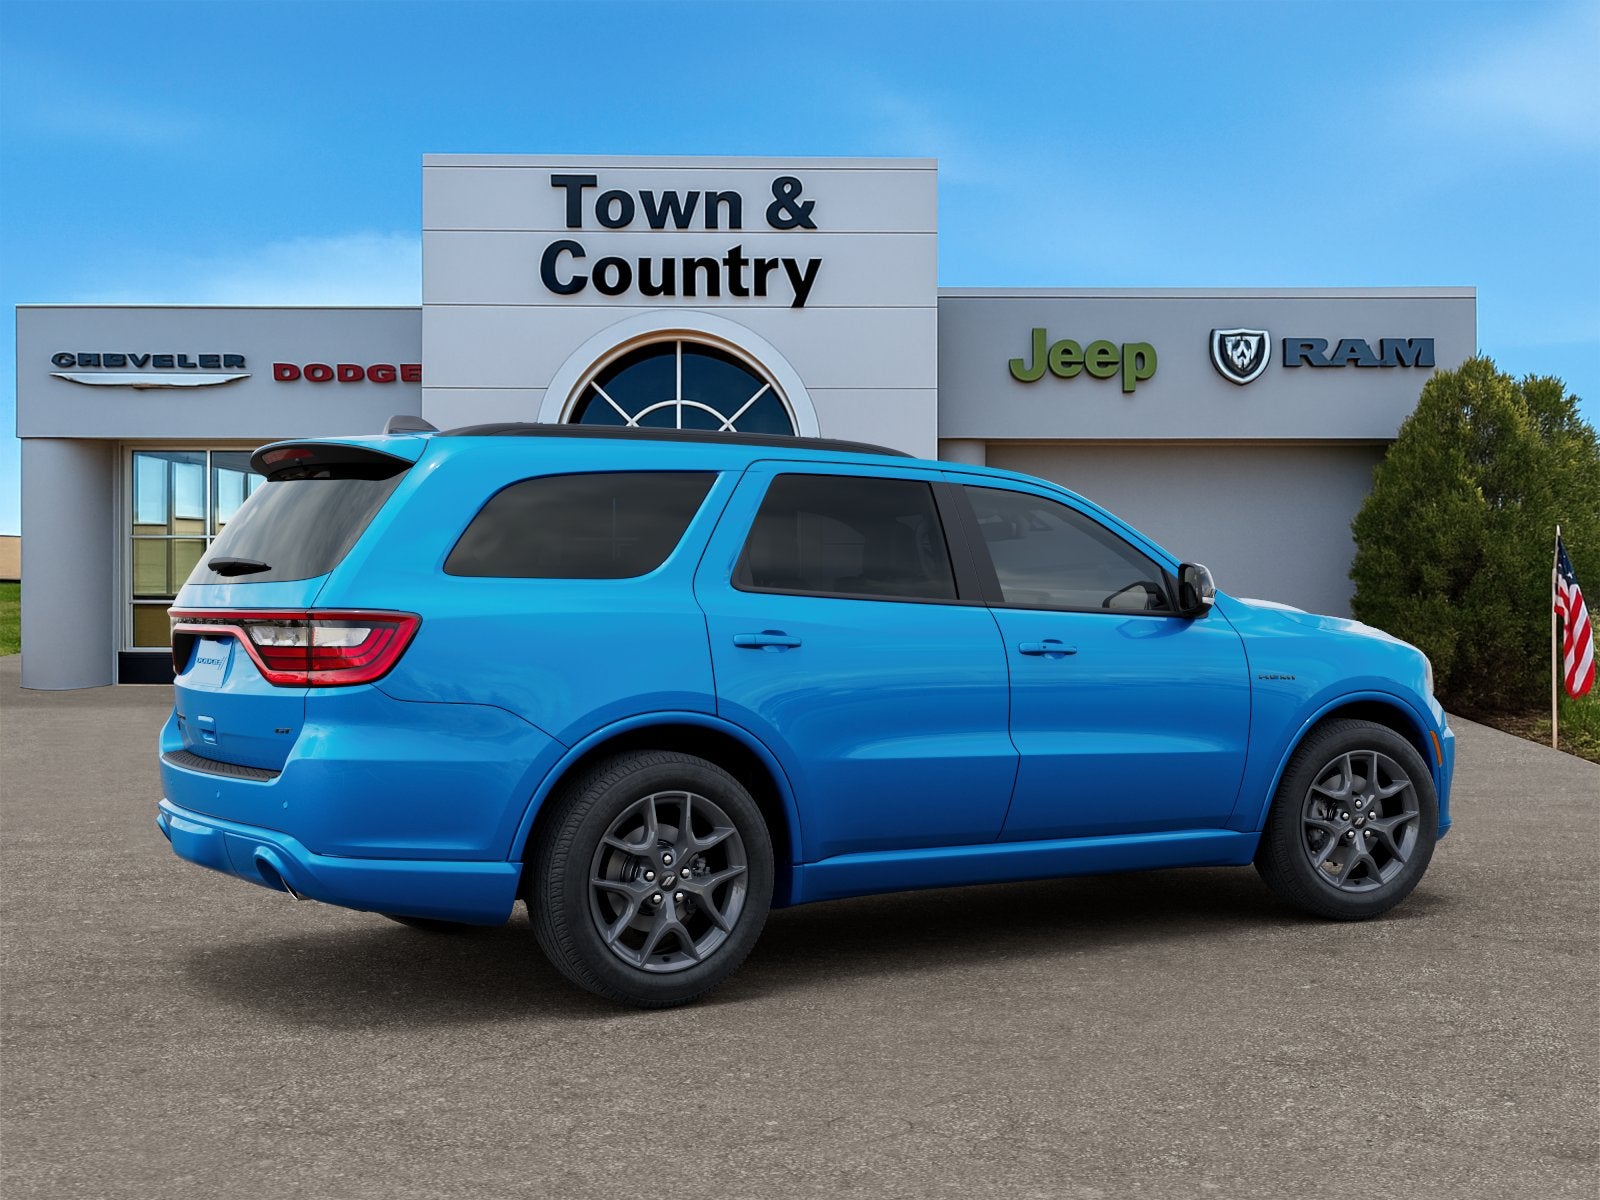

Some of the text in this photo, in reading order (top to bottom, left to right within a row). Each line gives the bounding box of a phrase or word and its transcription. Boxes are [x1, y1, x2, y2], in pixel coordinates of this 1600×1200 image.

[551, 174, 818, 229] Town &
[540, 239, 822, 308] Country
[273, 363, 421, 382] DODGE
[1009, 328, 1157, 392] Jeep
[1283, 337, 1435, 367] RAM
